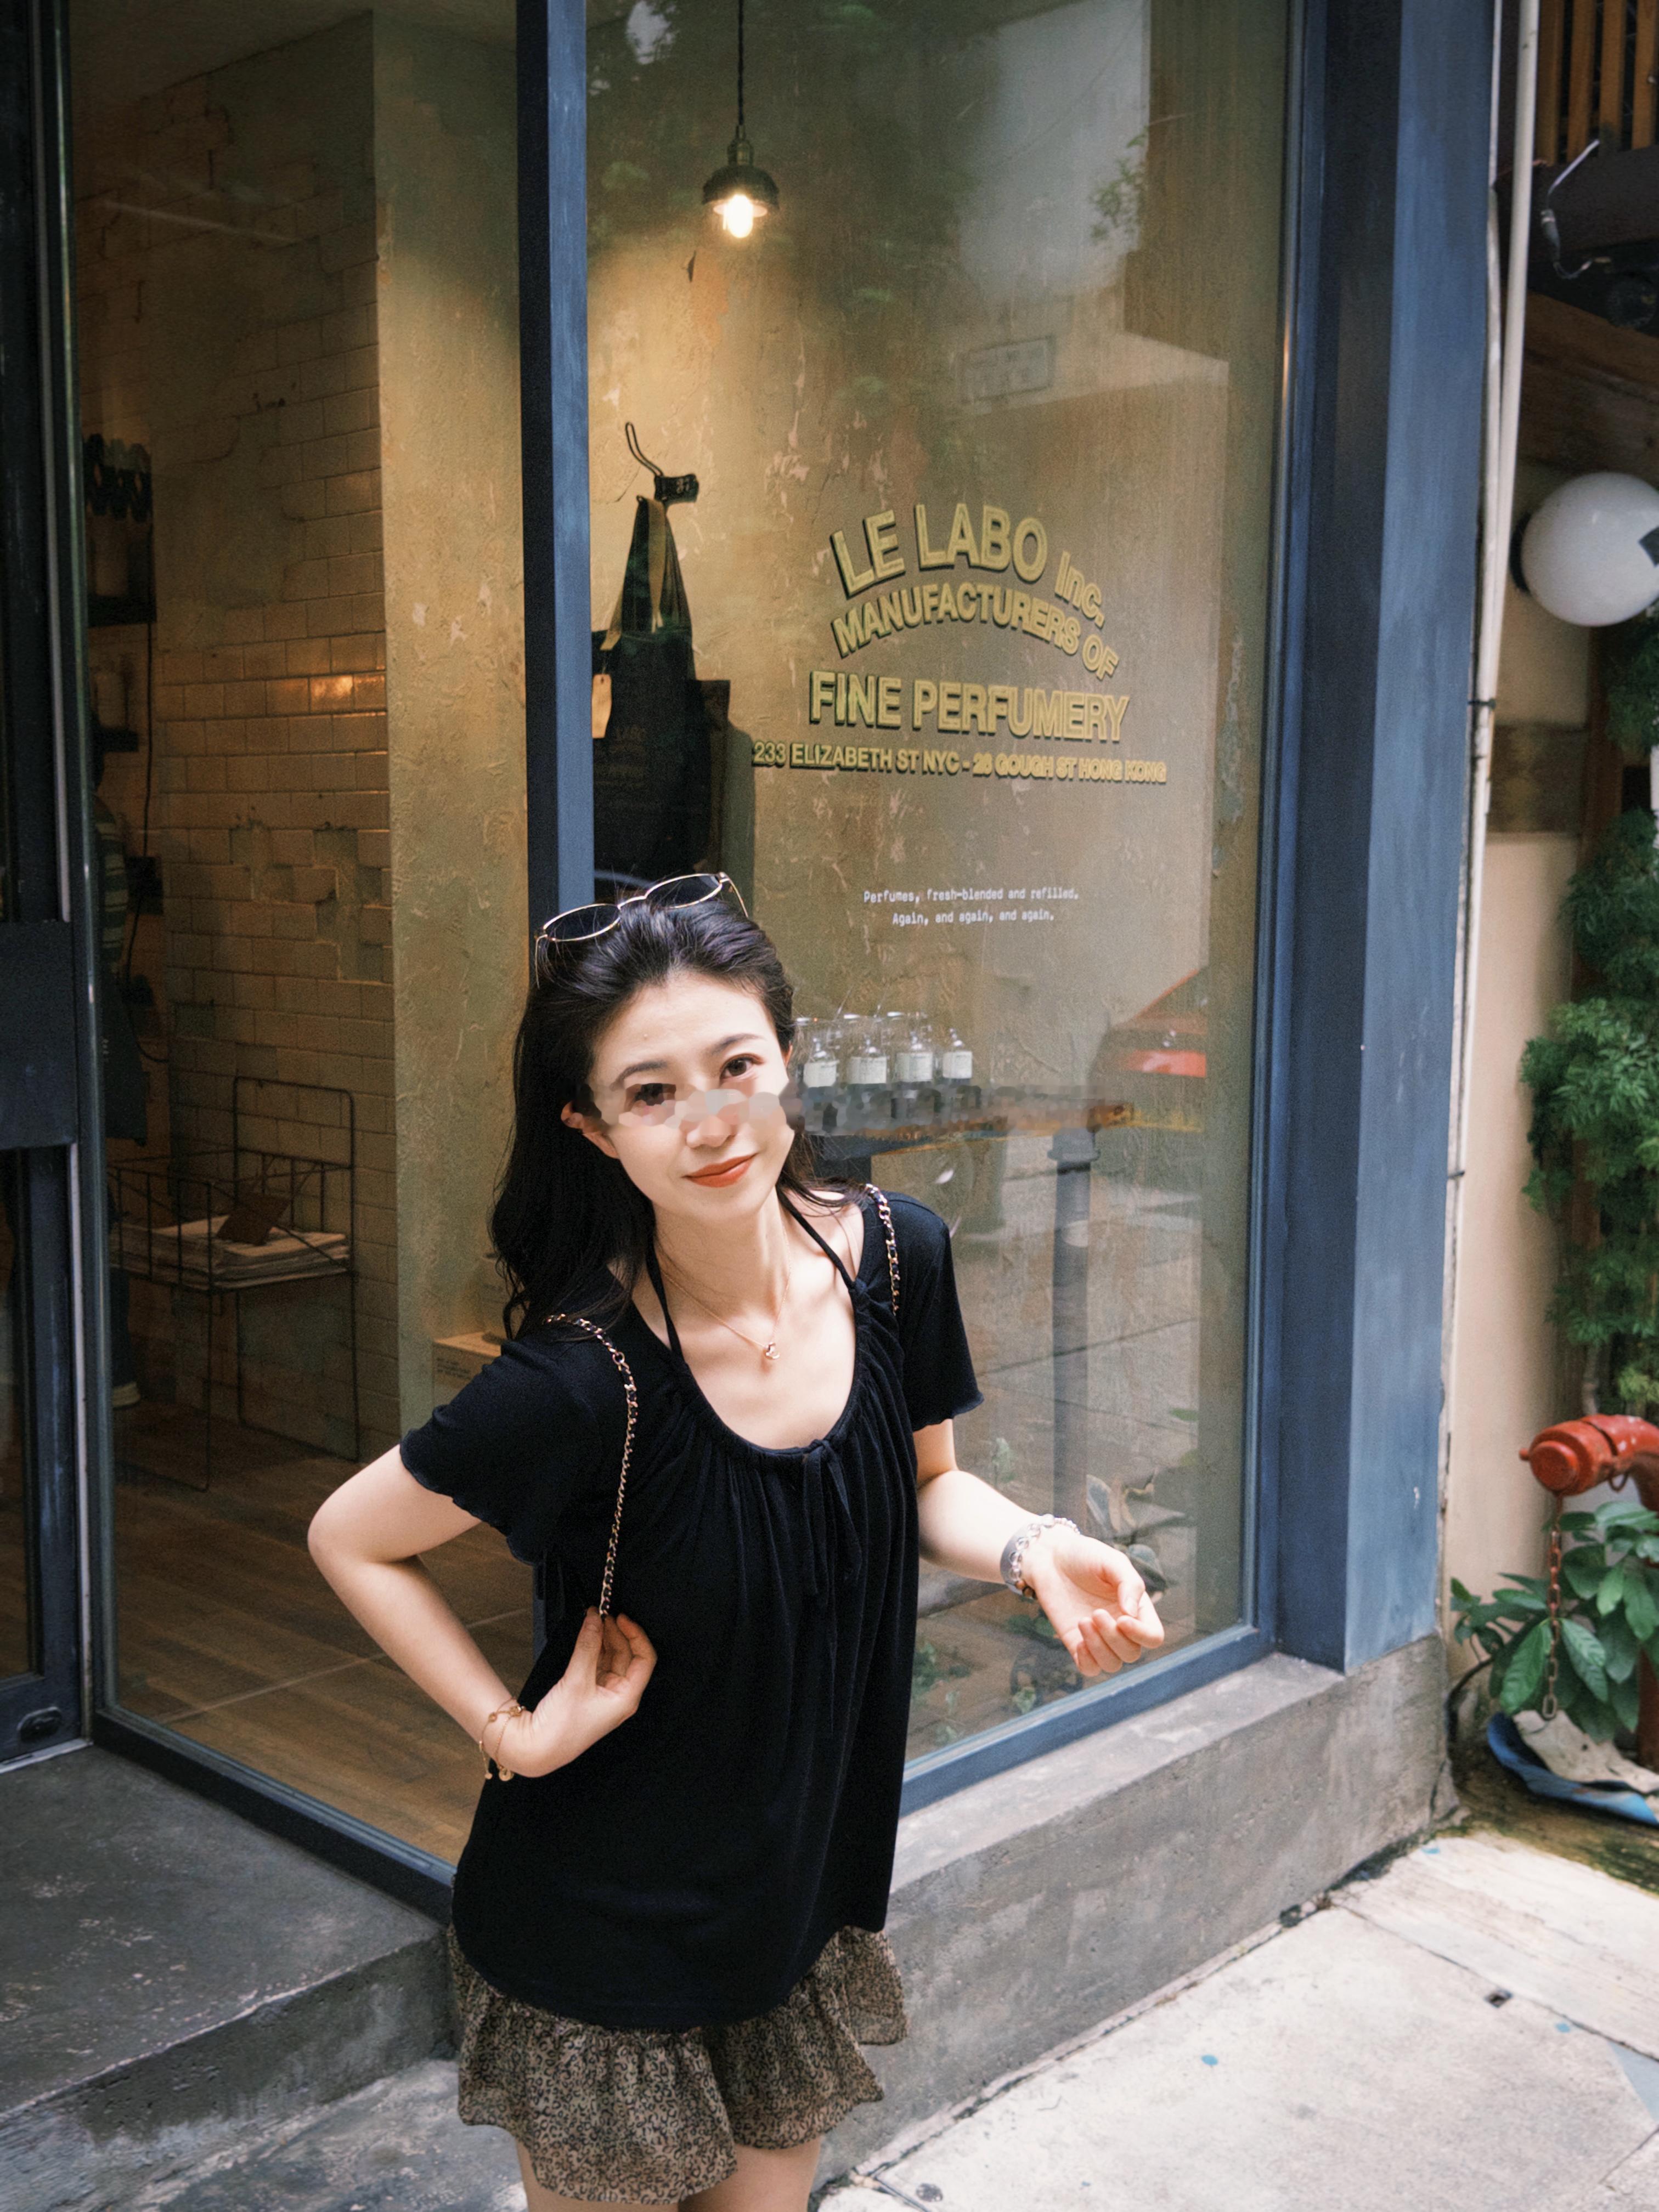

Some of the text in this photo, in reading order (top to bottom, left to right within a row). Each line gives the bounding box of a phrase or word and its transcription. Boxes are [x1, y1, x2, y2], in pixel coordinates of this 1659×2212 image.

[830, 503, 1105, 629] LE LABO Inc.
[831, 582, 1119, 680] MANUFACTURERS OF
[809, 670, 1130, 743] FINE PERFUMERY
[752, 742, 786, 767] 233
[789, 743, 892, 773] ELIZABETH
[895, 749, 920, 774] ST
[922, 750, 960, 776] NYC
[995, 753, 1054, 779] GOUGH
[1056, 756, 1077, 781] ST
[1078, 757, 1122, 783] HONG
[1124, 759, 1167, 784] KONG
[864, 890, 921, 904] Perfumes,
[927, 888, 1003, 901] fresh-blended
[1008, 889, 1025, 899] and
[892, 912, 929, 926] Again,
[935, 912, 953, 923] and
[958, 909, 994, 925] again,
[999, 909, 1016, 921] and
